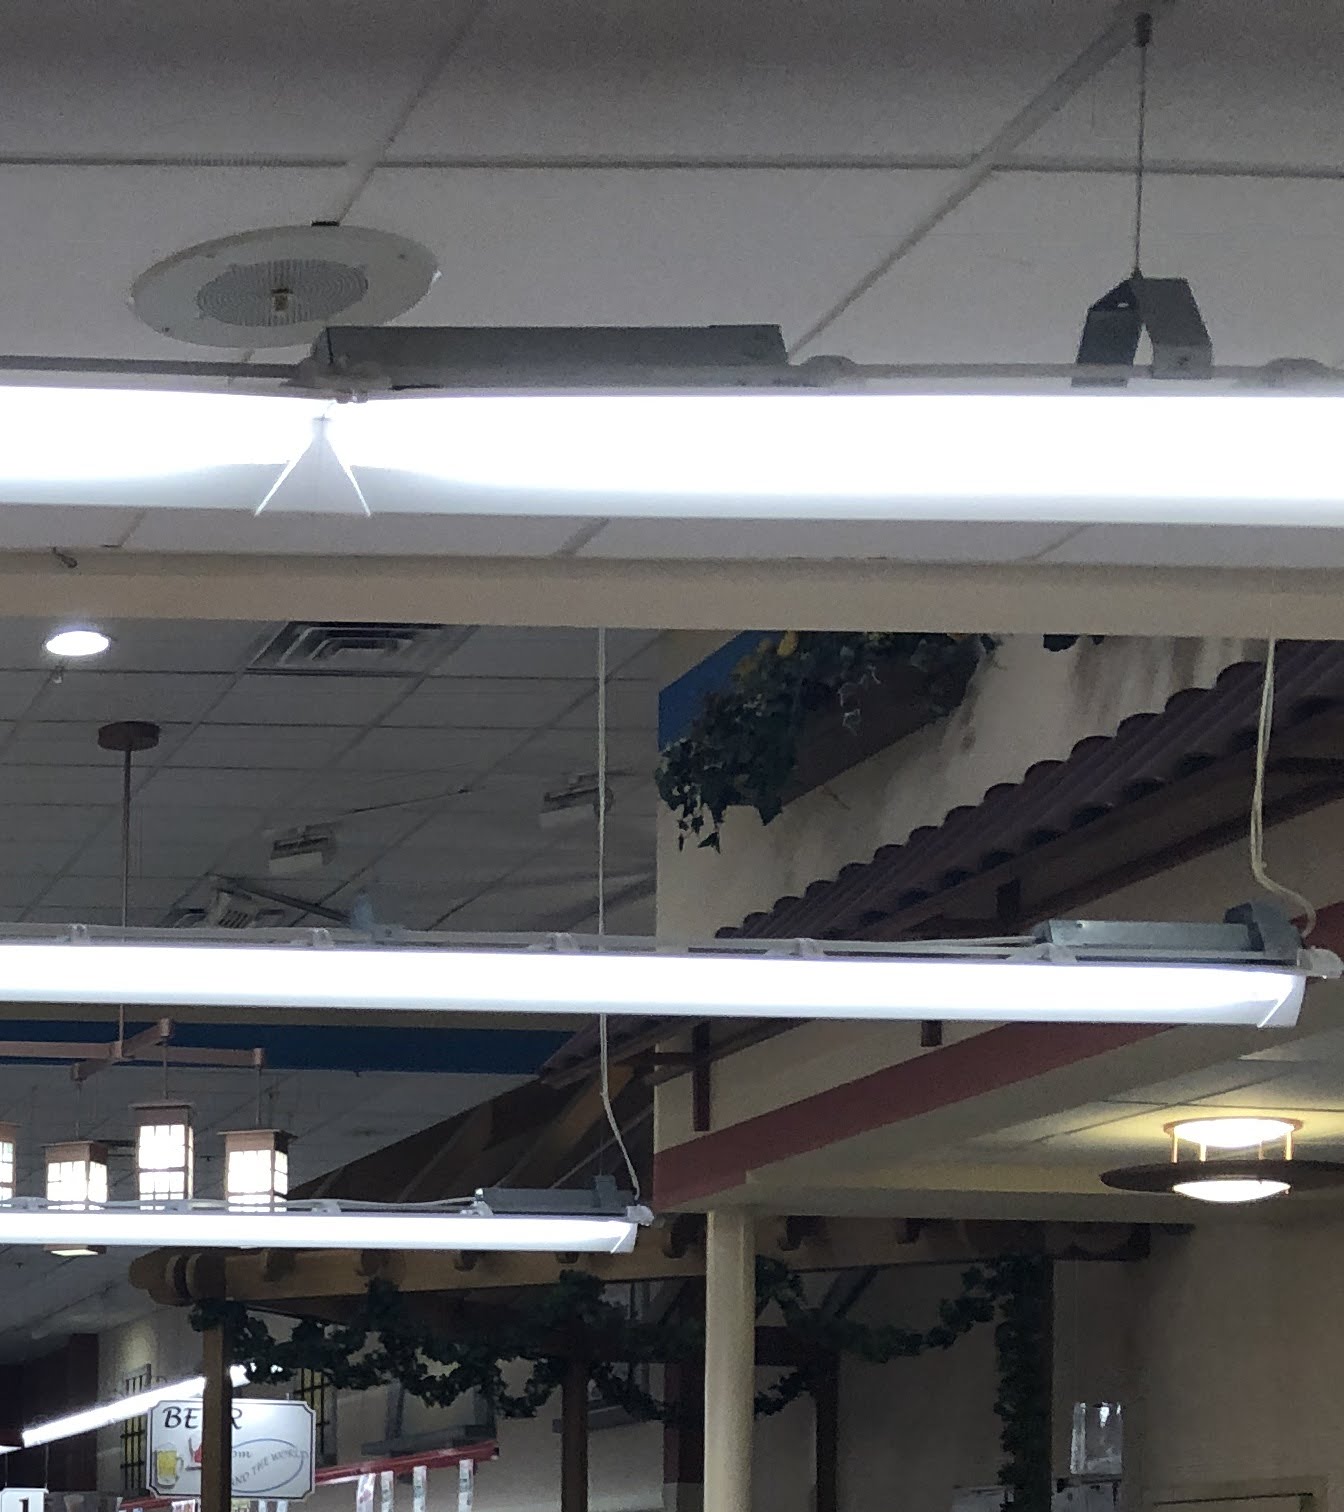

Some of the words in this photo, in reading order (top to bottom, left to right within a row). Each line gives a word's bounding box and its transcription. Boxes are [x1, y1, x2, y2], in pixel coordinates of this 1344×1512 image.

[163, 1406, 242, 1430] BER
[251, 1457, 269, 1474] THE
[271, 1449, 309, 1463] WORLD
